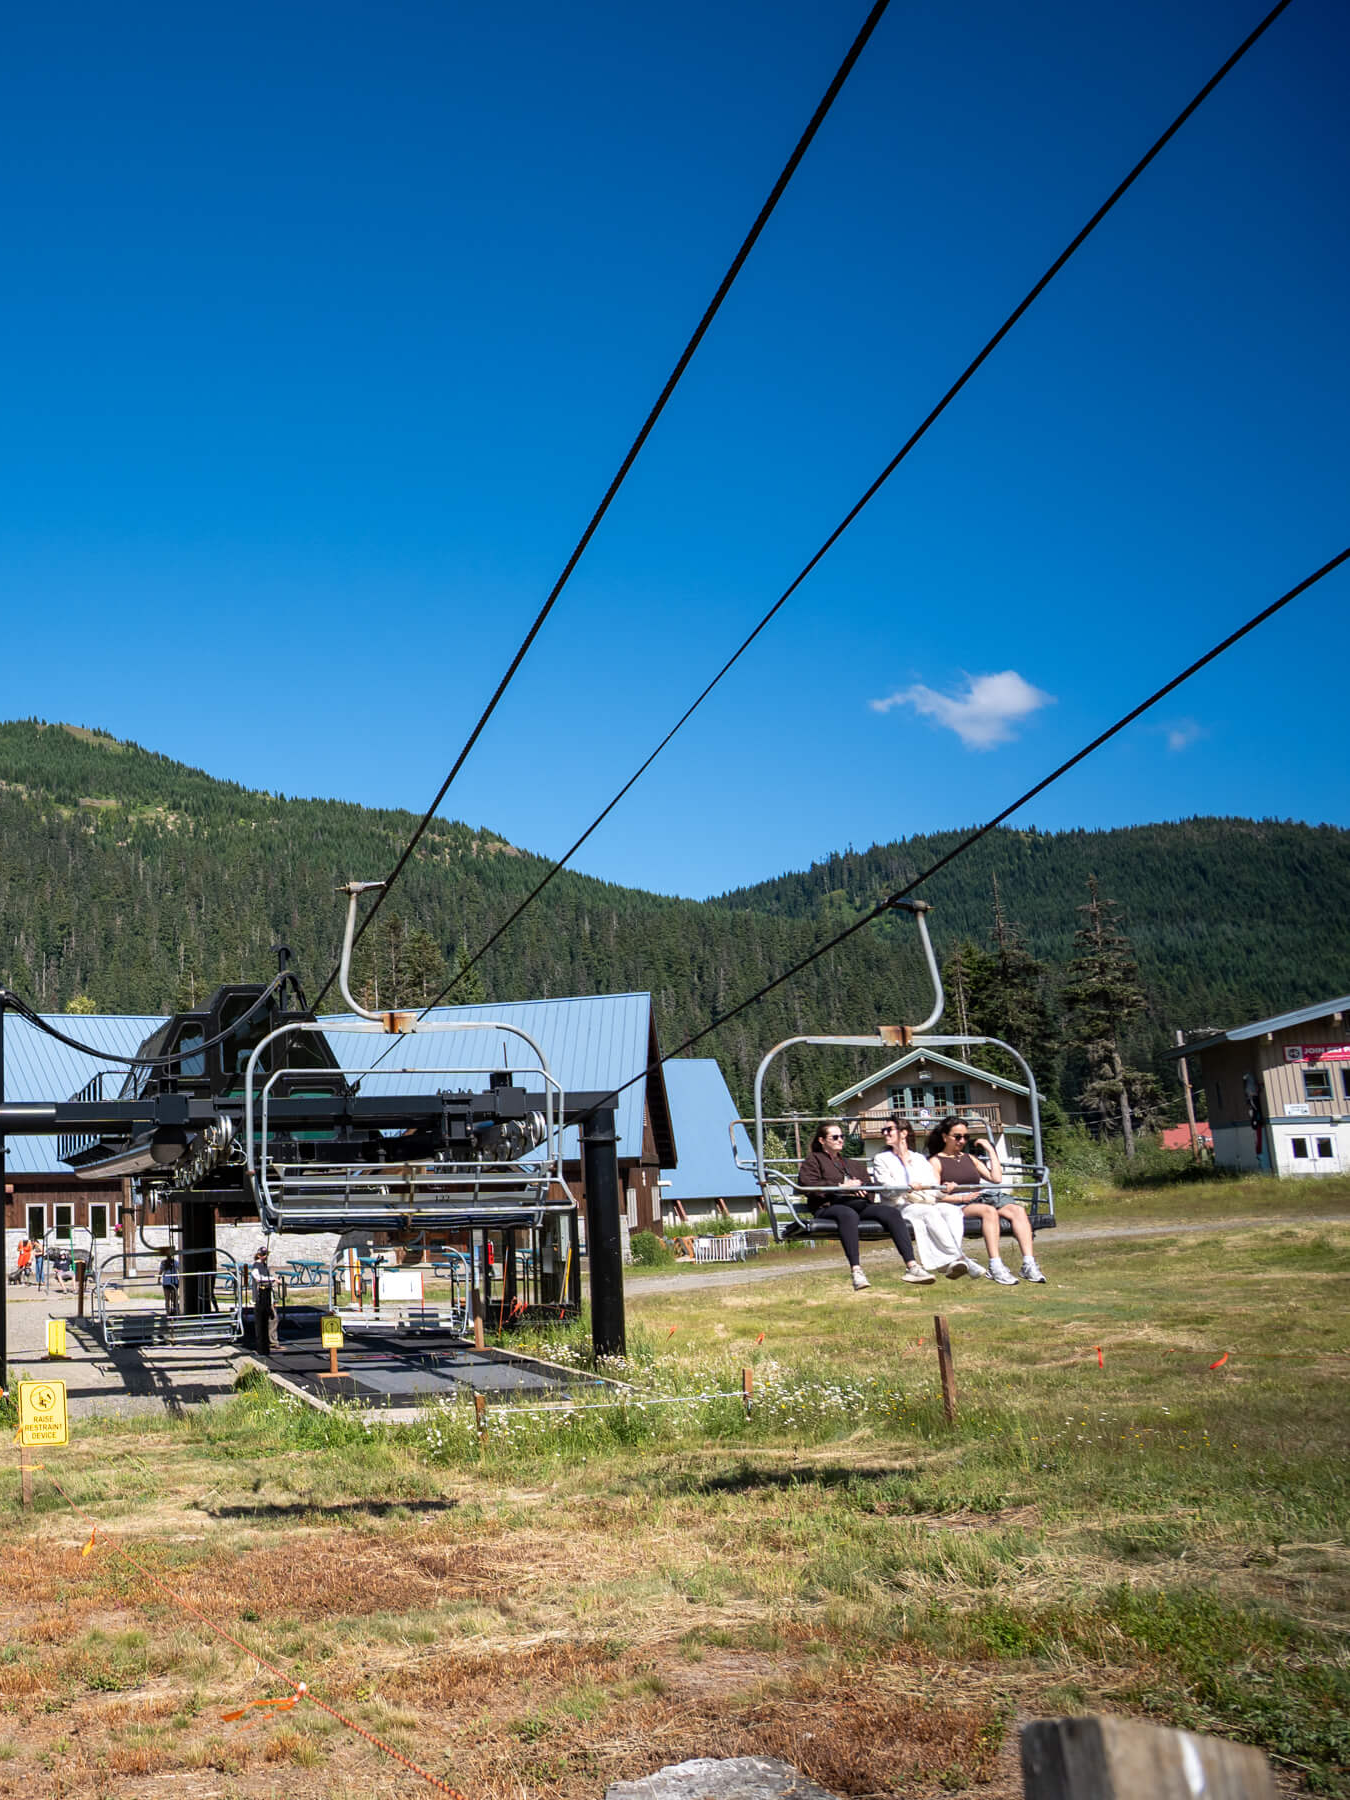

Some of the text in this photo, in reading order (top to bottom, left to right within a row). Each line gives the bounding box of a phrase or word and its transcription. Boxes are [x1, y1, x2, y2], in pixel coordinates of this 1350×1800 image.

[33, 1415, 54, 1423] RAISE
[24, 1423, 62, 1432] RESTRAINT
[31, 1431, 57, 1440] DEVICE
